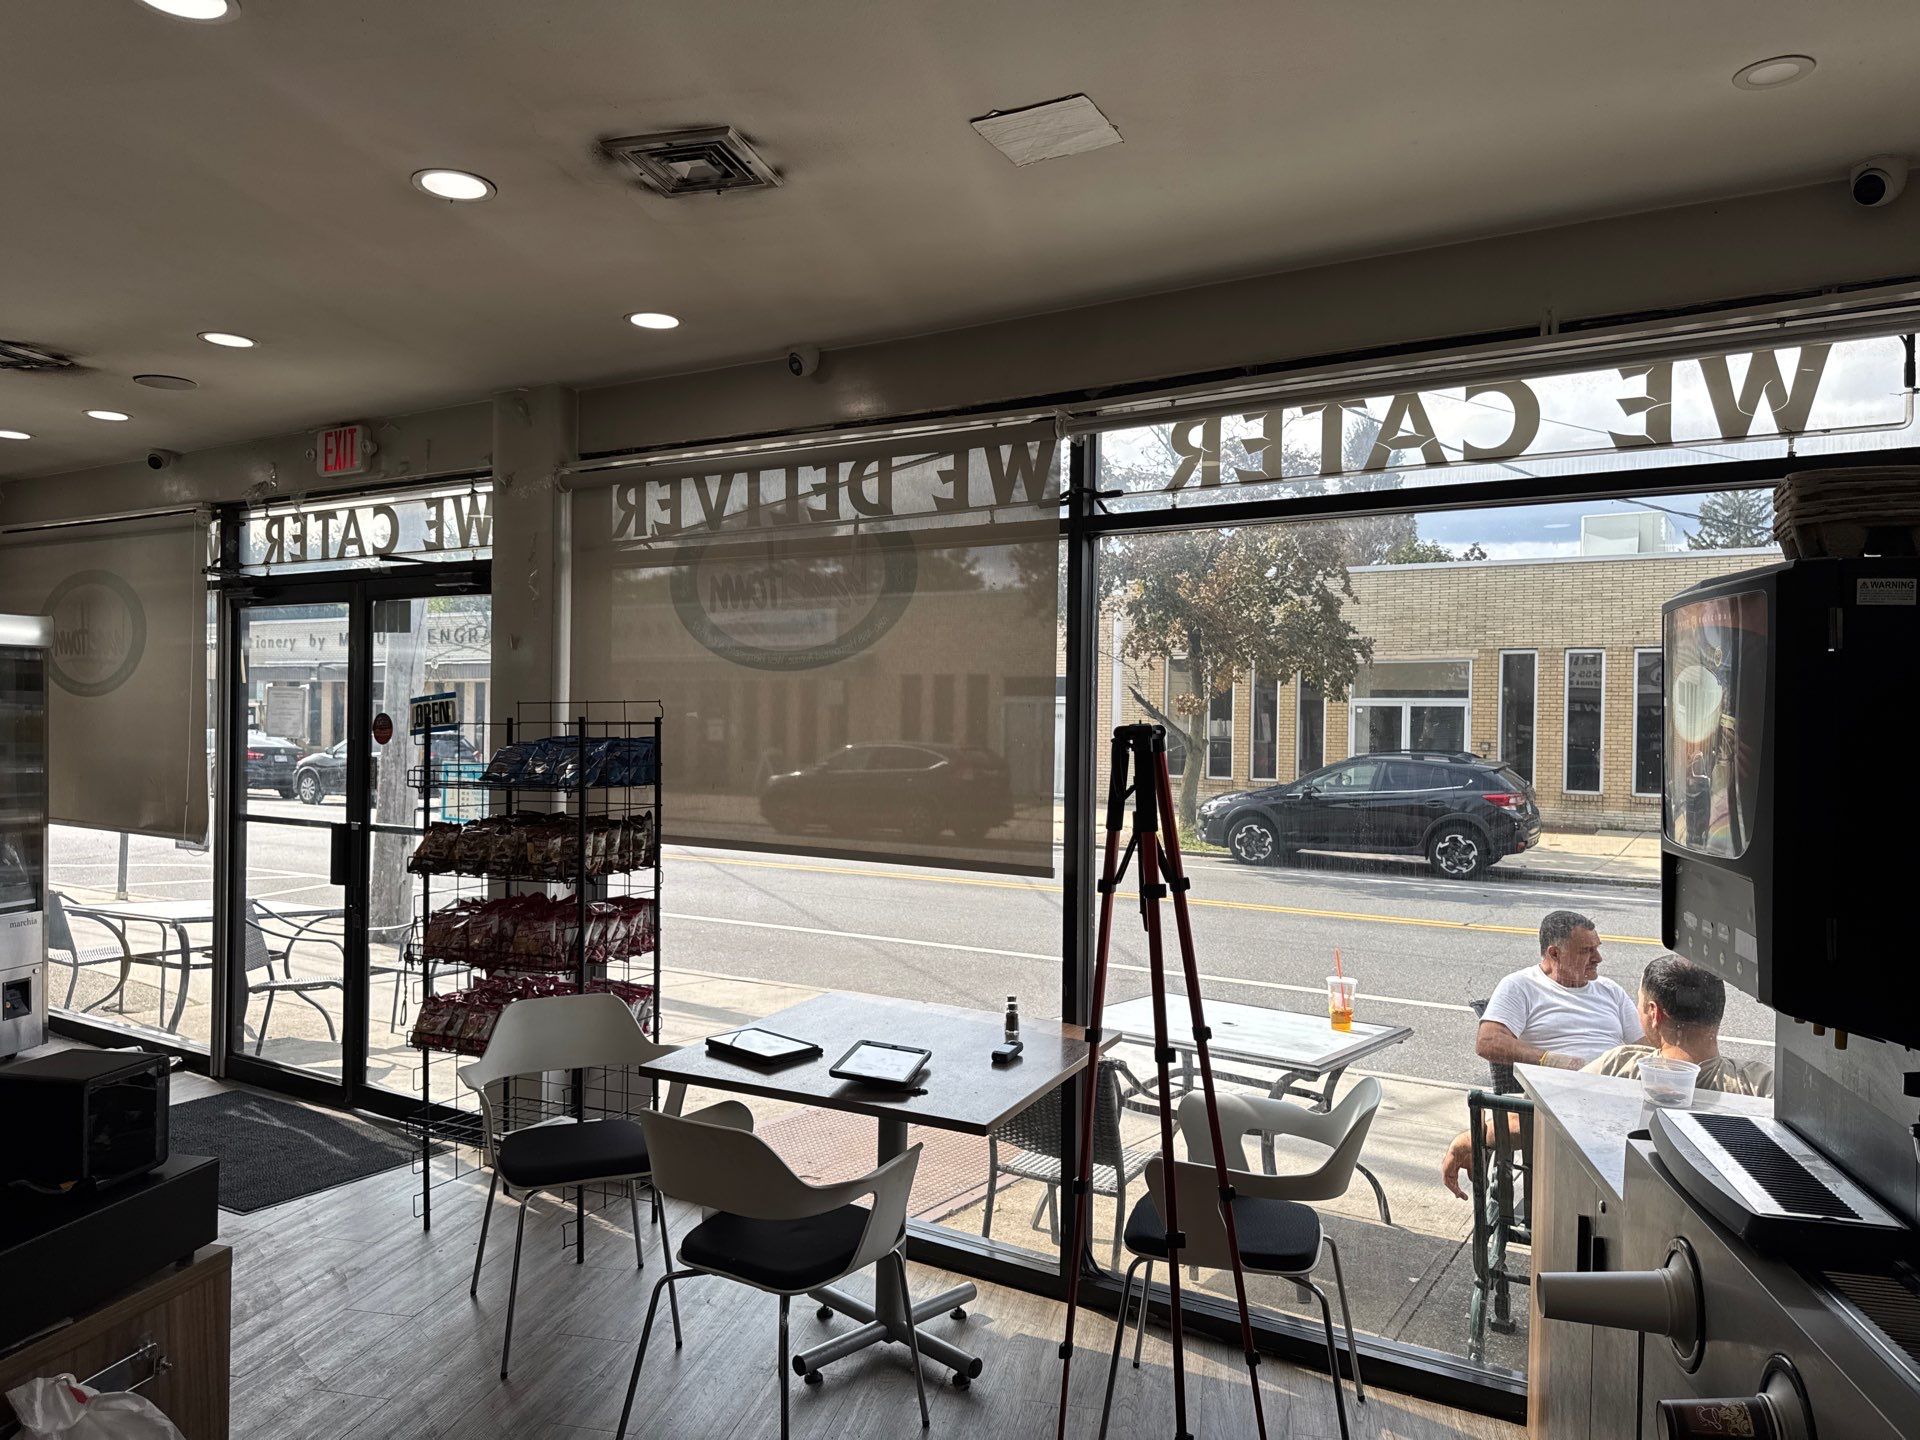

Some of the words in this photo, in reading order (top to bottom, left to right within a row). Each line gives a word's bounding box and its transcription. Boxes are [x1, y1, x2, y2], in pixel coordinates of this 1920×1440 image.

[324, 428, 357, 472] EXIT
[1871, 581, 1915, 589] WARNING
[309, 633, 326, 650] by
[415, 700, 451, 727] OPEN
[10, 918, 38, 928] marchia
